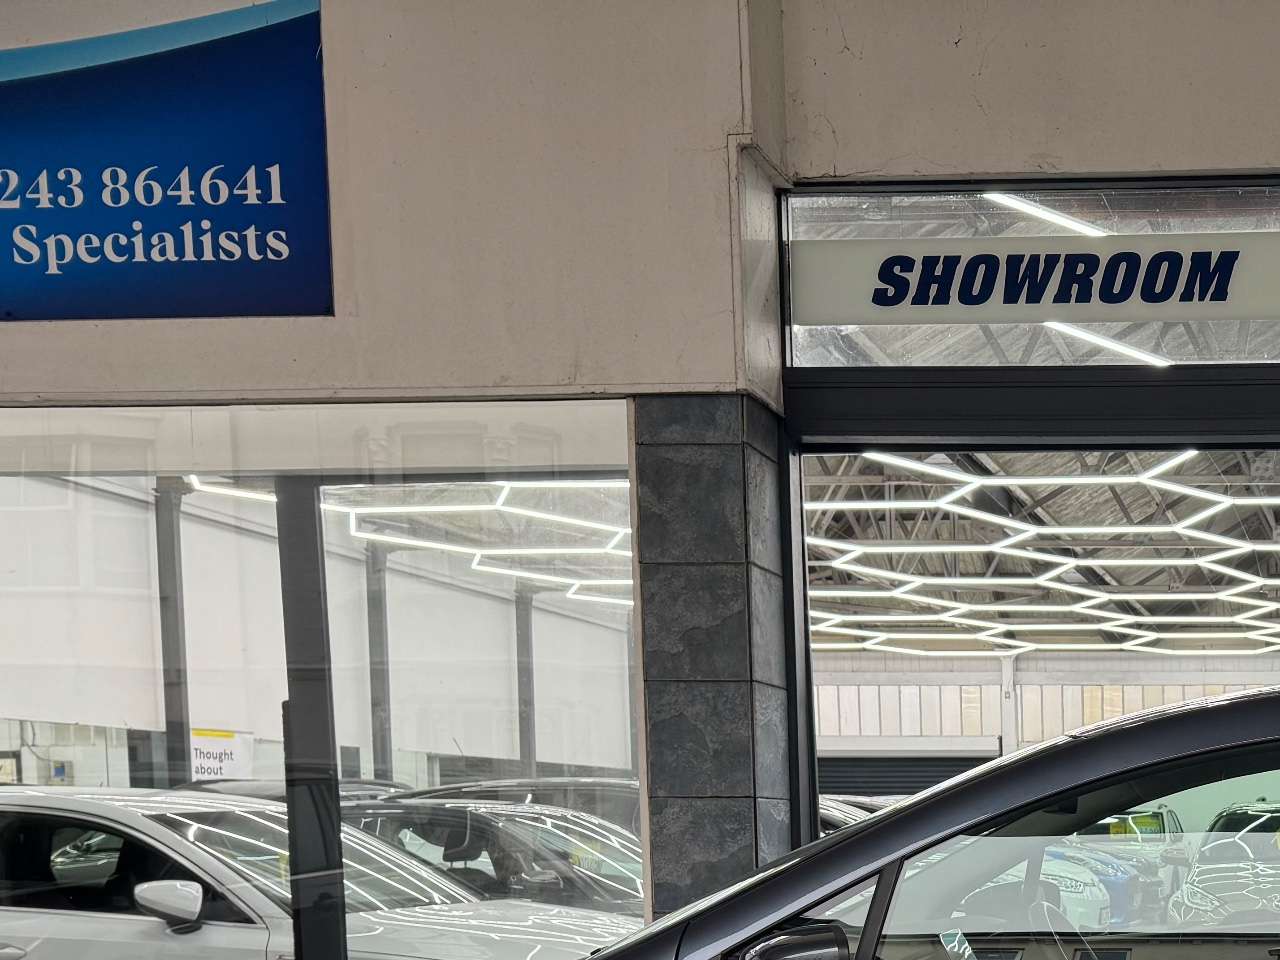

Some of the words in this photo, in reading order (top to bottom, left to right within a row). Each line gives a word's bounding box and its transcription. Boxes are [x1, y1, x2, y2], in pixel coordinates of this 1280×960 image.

[0, 167, 84, 209] 243
[101, 163, 287, 206] 864641
[12, 219, 290, 274] Specialists
[871, 250, 1240, 306] SHOWROOM
[194, 747, 234, 763] Thought
[194, 763, 223, 775] about
